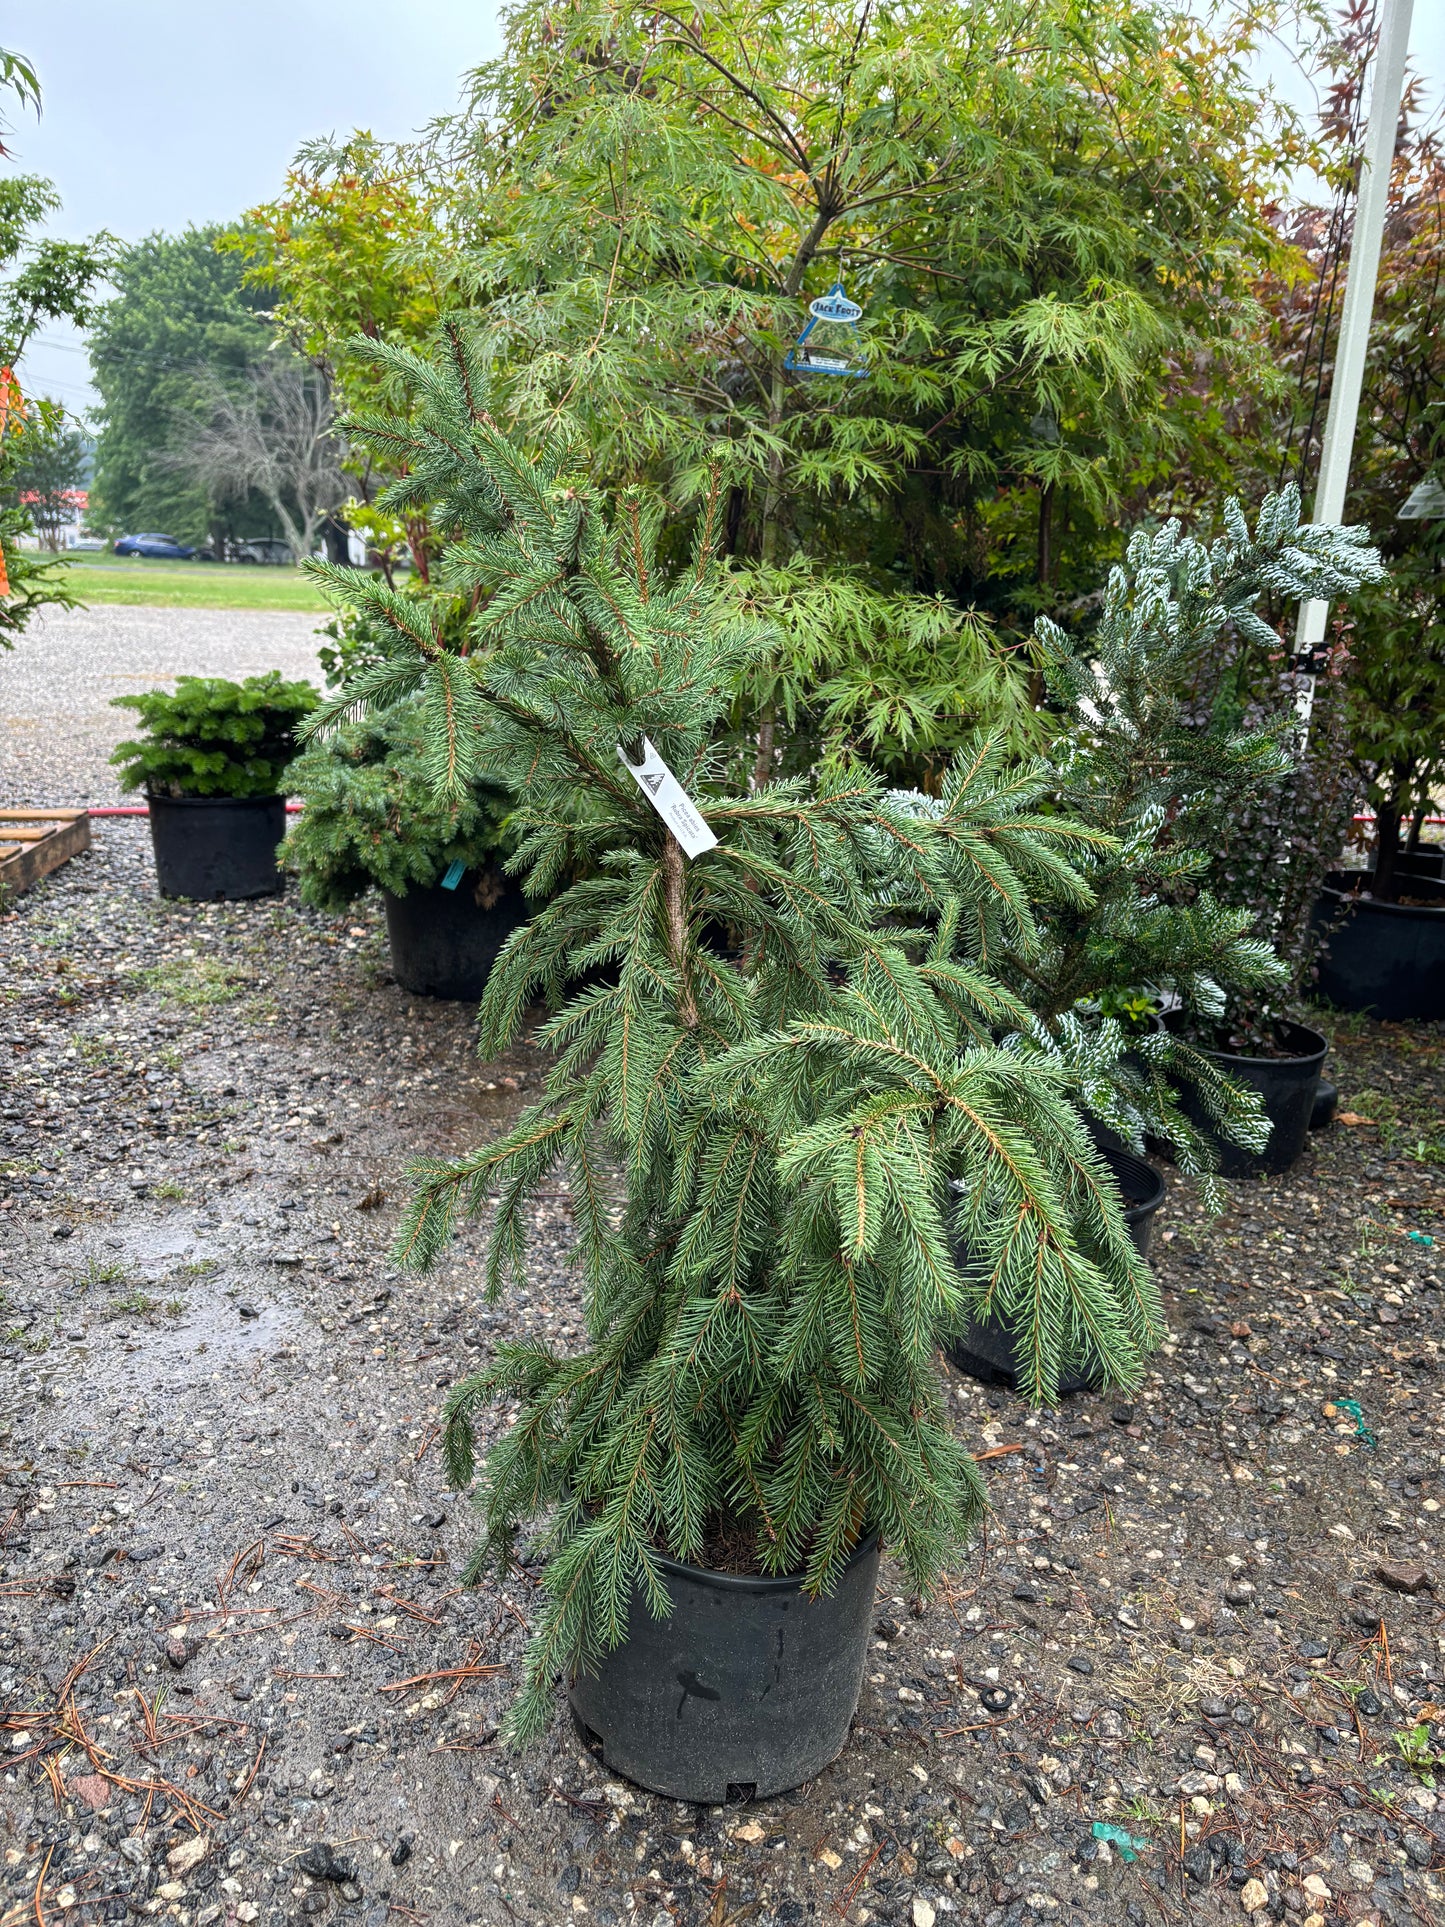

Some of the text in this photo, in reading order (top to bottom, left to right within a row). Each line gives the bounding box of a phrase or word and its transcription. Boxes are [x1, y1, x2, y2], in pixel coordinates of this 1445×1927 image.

[814, 302, 834, 312] JACK
[836, 304, 861, 316] FROST
[678, 803, 700, 832] Picea abies
